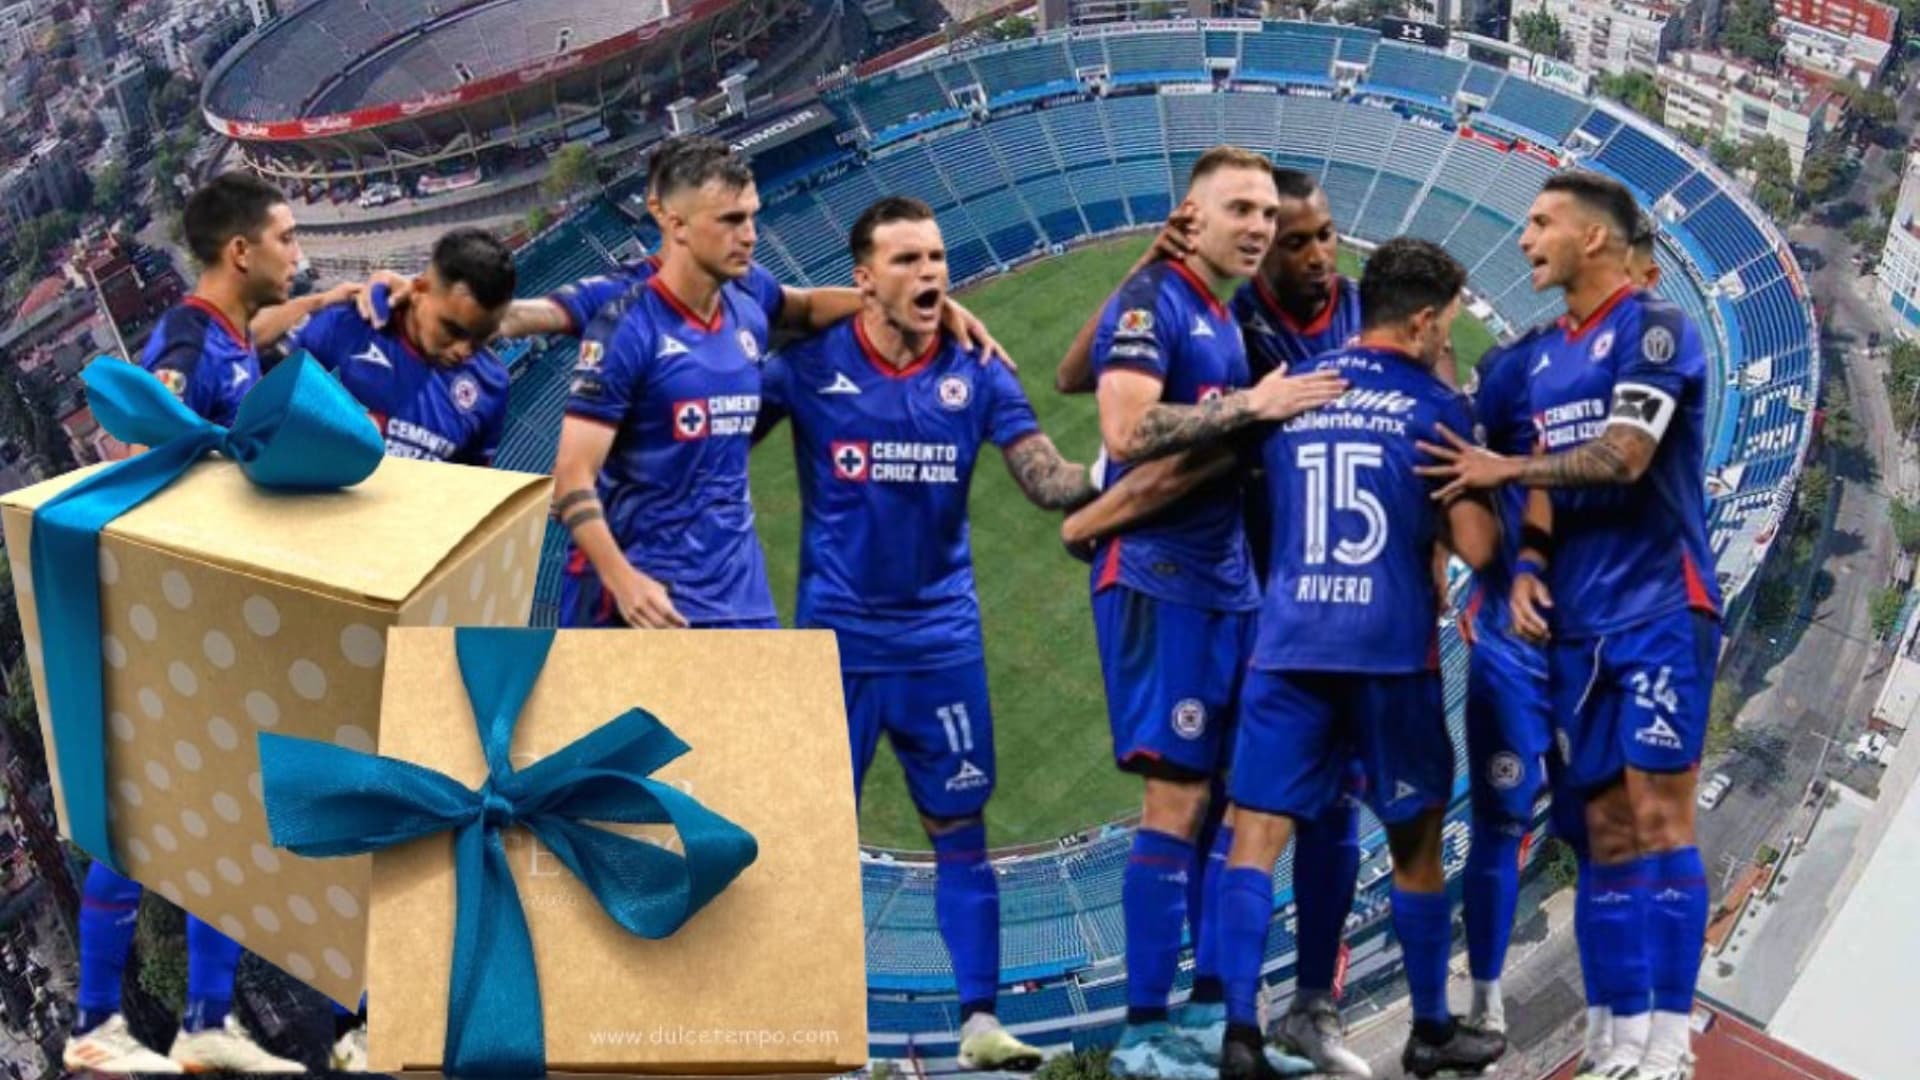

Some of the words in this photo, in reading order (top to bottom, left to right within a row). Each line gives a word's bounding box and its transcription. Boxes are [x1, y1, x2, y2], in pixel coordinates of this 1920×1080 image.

[1544, 399, 1605, 426] CEMENTO
[872, 442, 957, 462] CEMENTO
[872, 463, 917, 481] CRUZ
[920, 465, 959, 482] AZUL
[1297, 442, 1388, 565] 15
[1297, 574, 1373, 605] RIVERO
[1631, 665, 1679, 713] 24
[936, 703, 974, 753] 11
